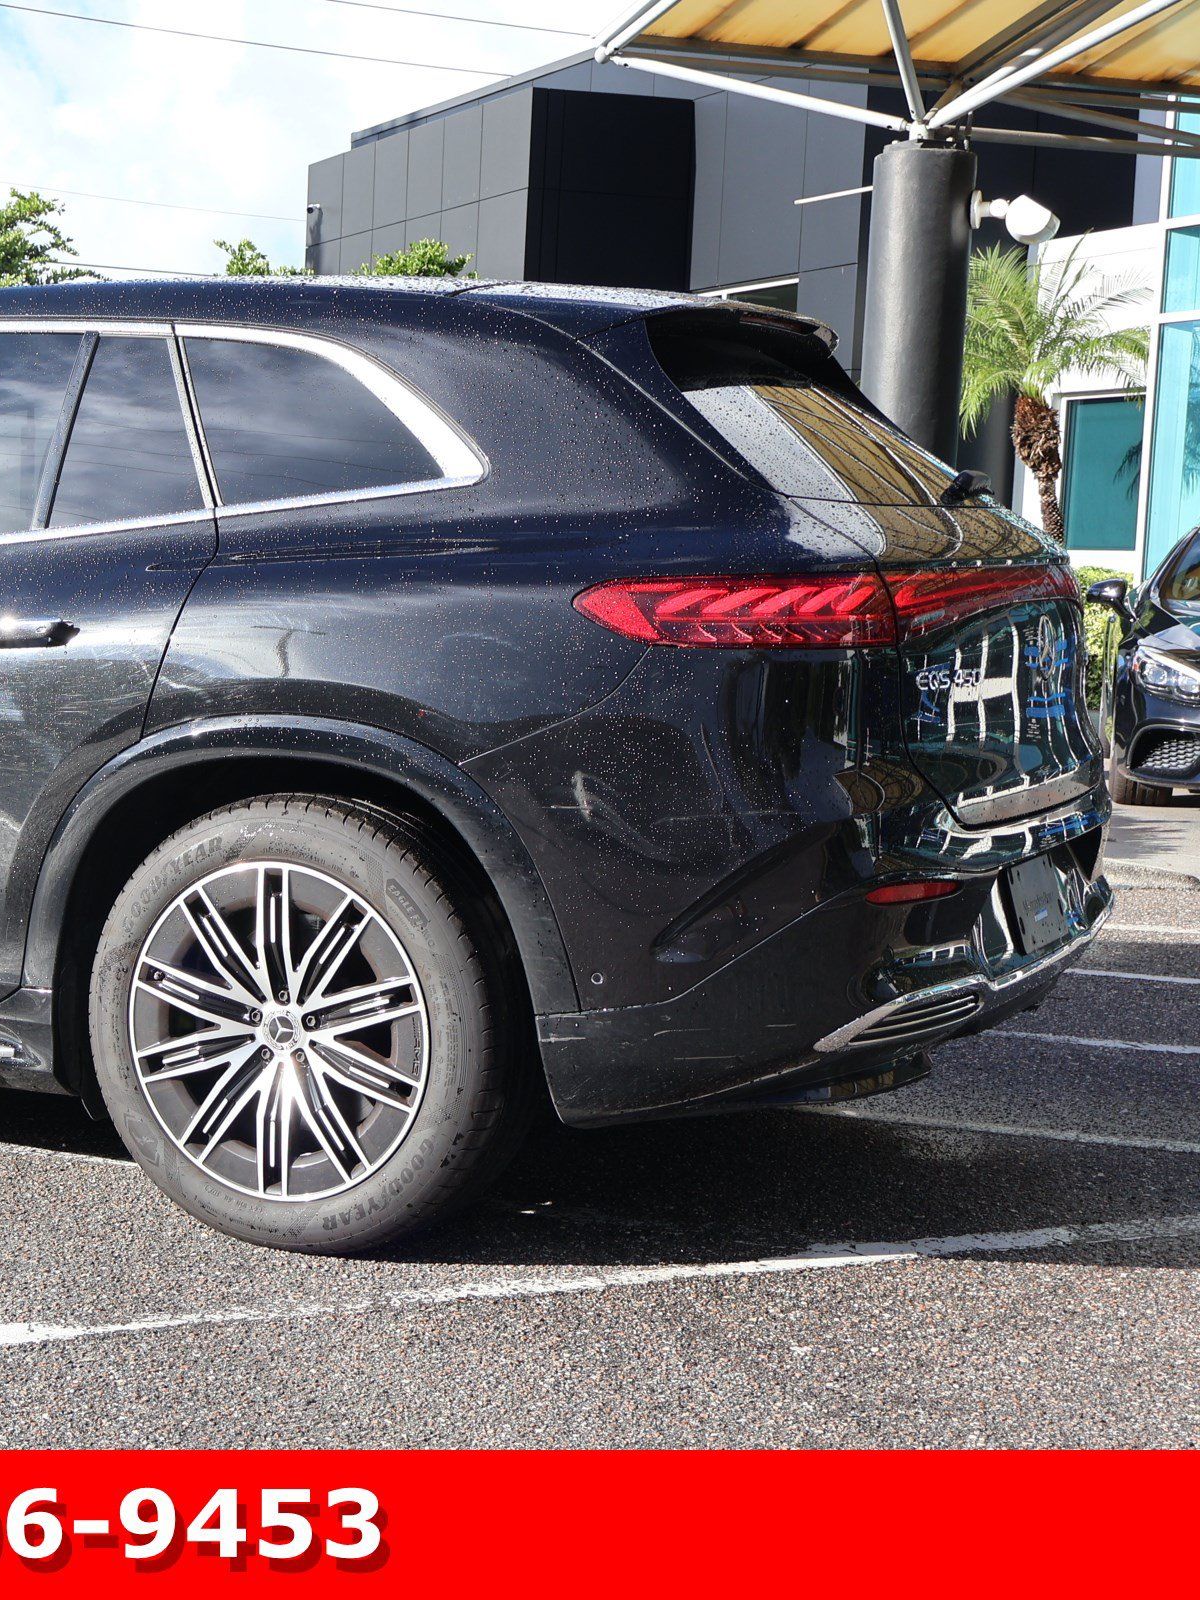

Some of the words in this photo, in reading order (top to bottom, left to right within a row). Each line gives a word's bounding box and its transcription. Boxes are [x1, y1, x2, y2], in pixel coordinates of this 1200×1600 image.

[915, 669, 951, 691] EQS
[953, 667, 982, 688] 450
[387, 884, 415, 914] EAGLE
[321, 1134, 437, 1232] GOODYEAR
